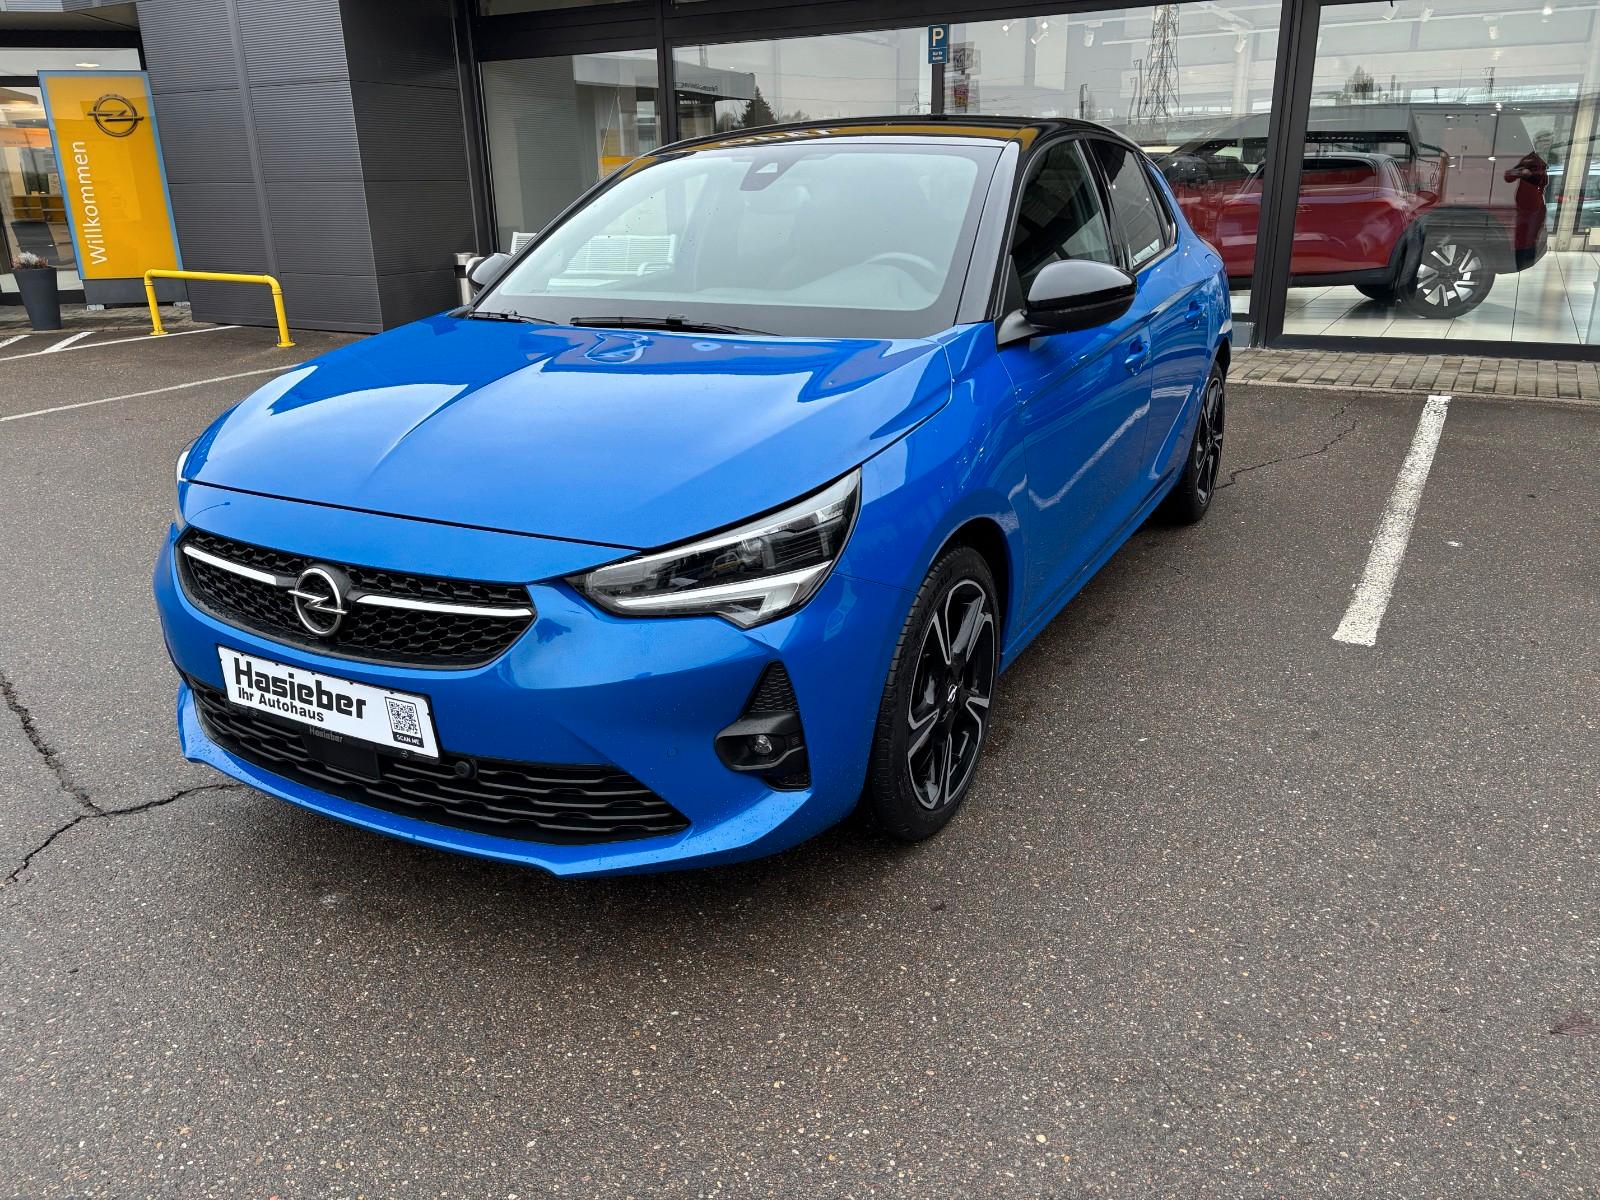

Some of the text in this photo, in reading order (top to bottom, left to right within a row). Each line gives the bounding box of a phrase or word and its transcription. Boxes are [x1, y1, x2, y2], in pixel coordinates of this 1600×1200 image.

[932, 27, 944, 47] P
[72, 141, 107, 265] Willkommen
[233, 657, 367, 719] Hasieber
[238, 686, 325, 722] Ihr Autohaus
[309, 726, 344, 743] Hasieber
